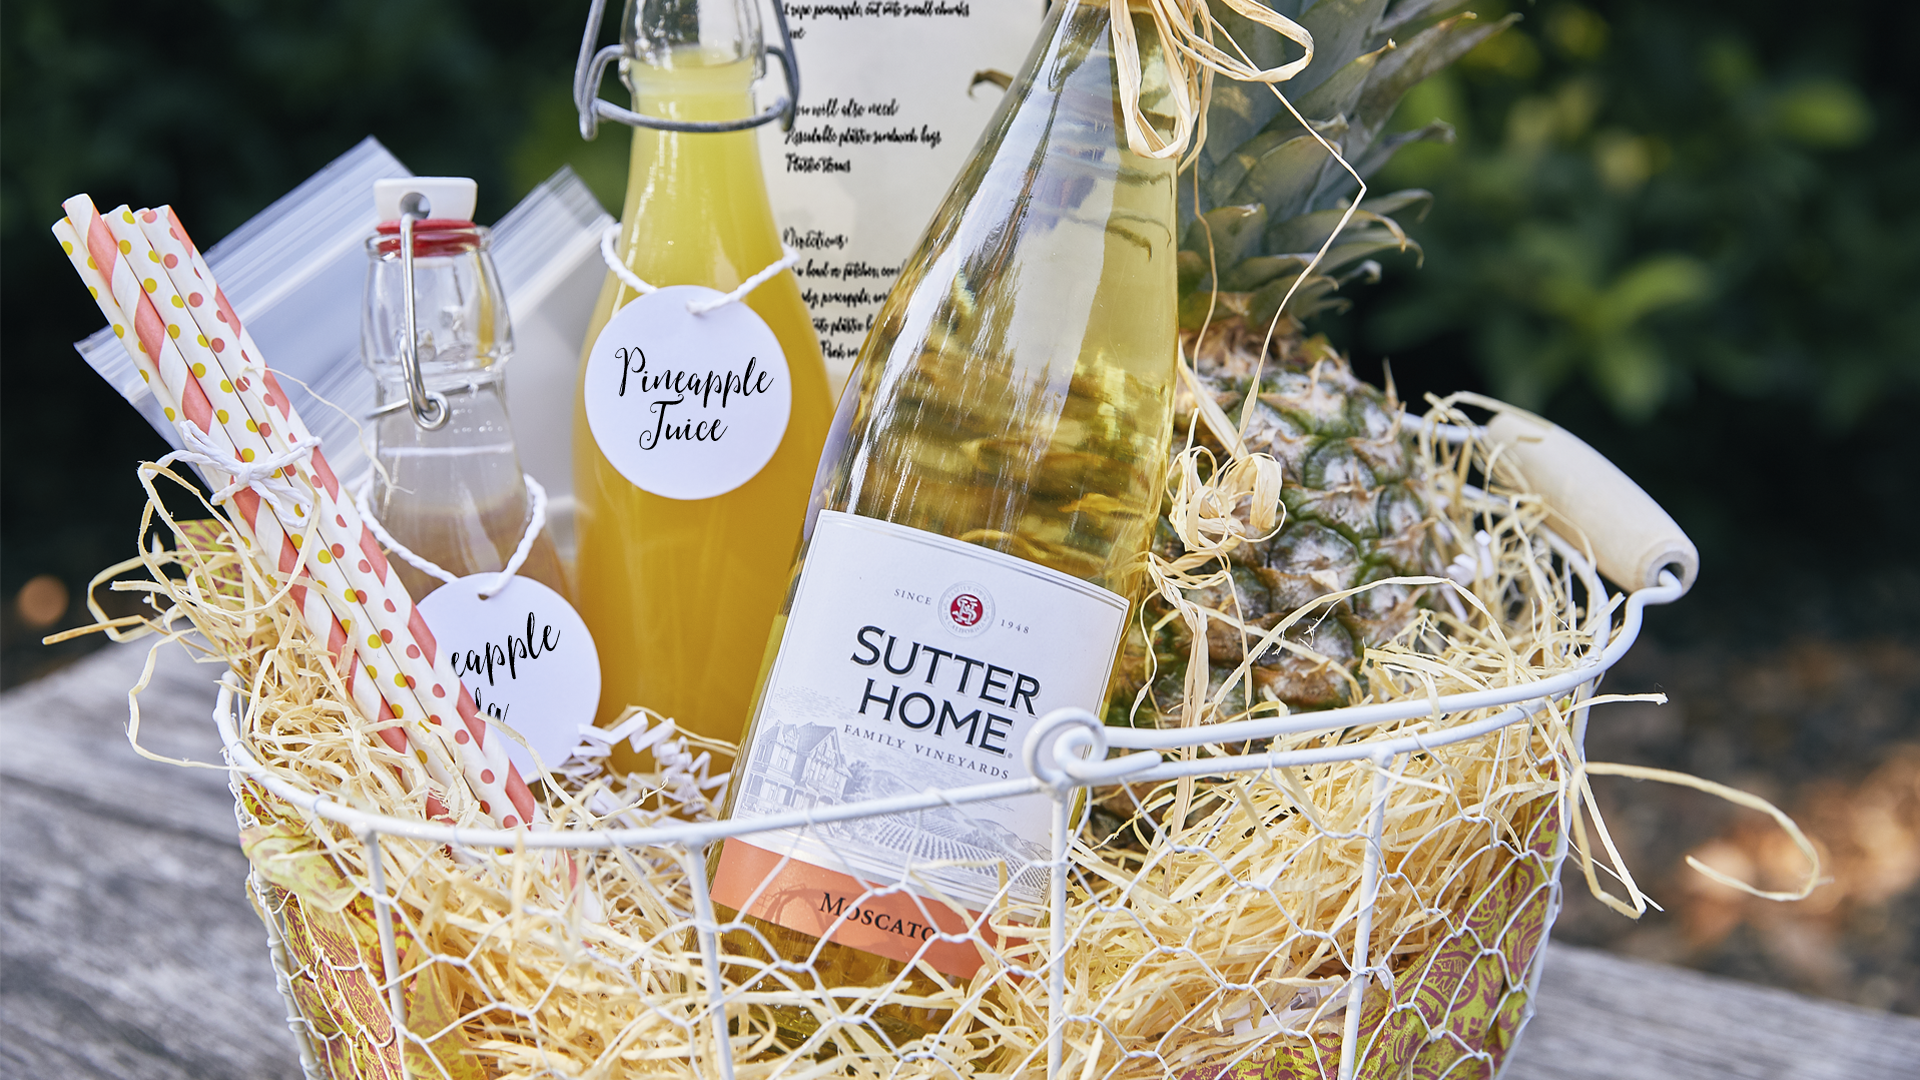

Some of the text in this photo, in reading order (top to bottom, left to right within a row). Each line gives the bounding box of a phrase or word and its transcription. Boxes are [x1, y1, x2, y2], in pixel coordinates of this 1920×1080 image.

[795, 97, 900, 117] ou will also need
[872, 127, 918, 144] sandwich
[615, 346, 775, 408] Pineapple
[639, 394, 728, 450] Juice
[894, 588, 1030, 634] SINCE 1948
[451, 612, 561, 686] eapple
[850, 625, 1041, 716] SUTTER
[858, 677, 1013, 755] HOME
[844, 724, 1010, 780] FAMILY VINEYARDS
